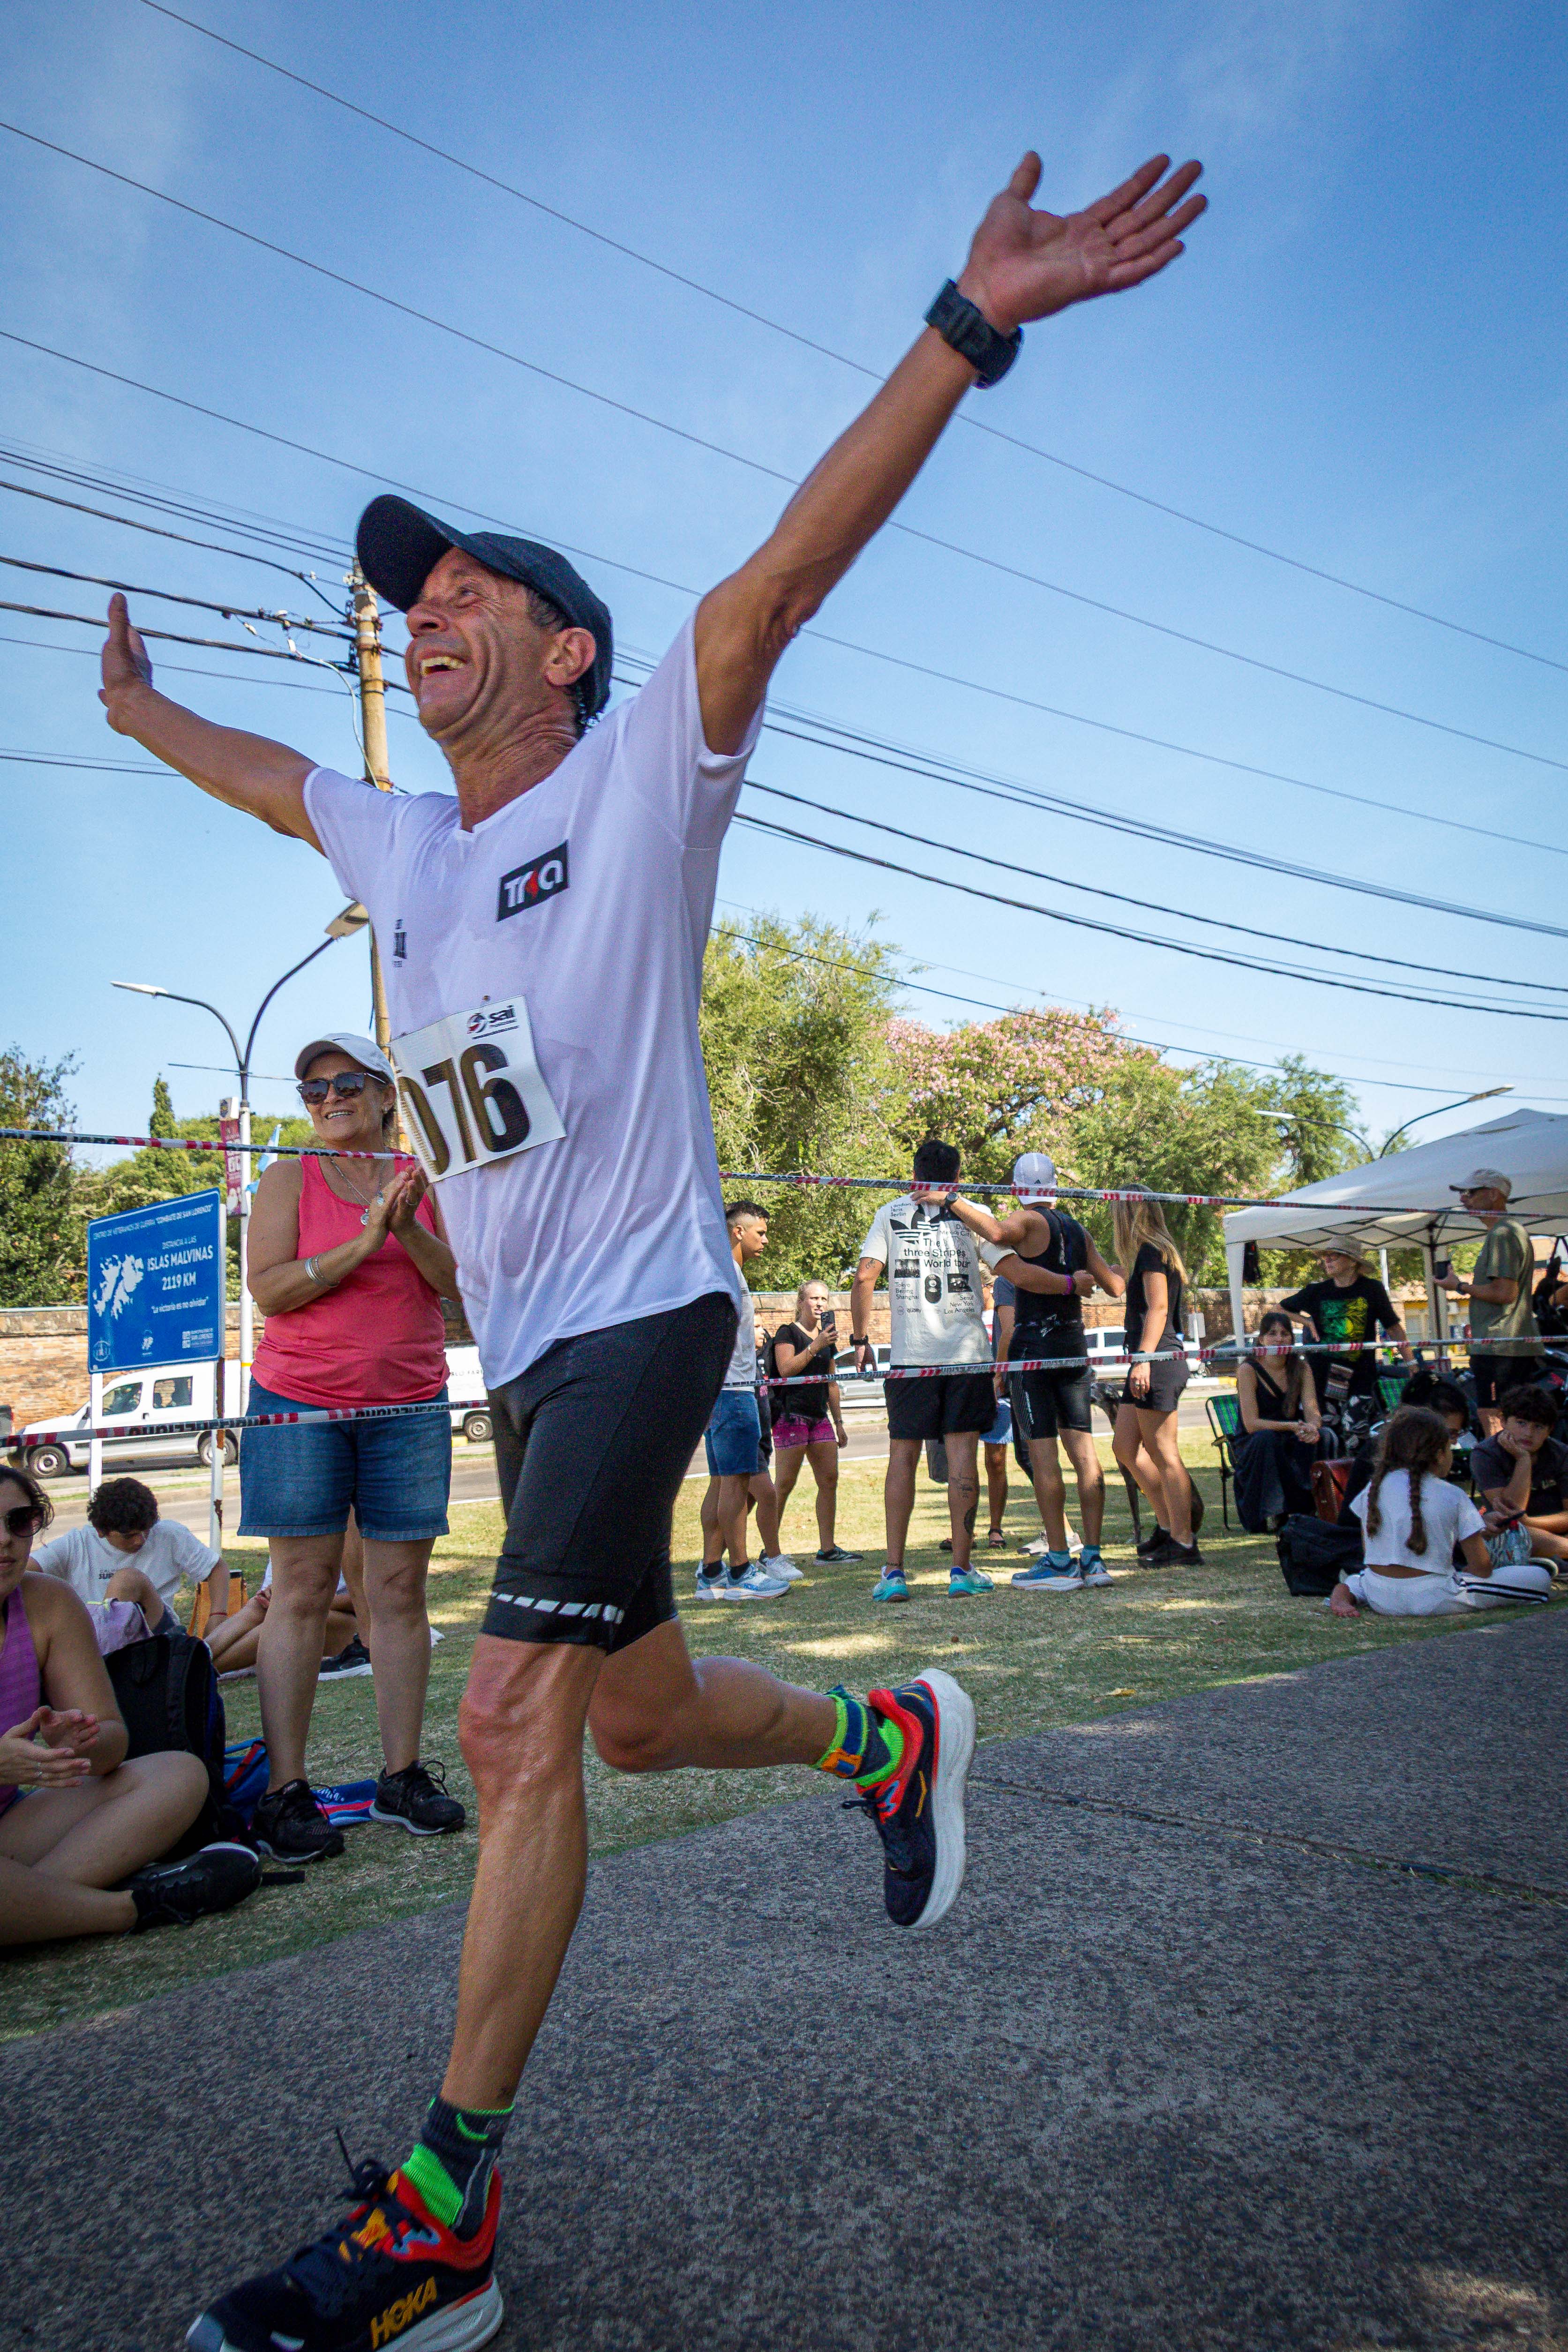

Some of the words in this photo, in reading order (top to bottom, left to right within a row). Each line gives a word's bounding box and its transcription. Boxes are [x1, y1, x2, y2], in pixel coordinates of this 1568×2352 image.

[923, 1238, 940, 1247] The
[147, 1254, 170, 1272] ISLAS
[171, 1245, 214, 1266] MALVINAS
[904, 1248, 930, 1257] three
[932, 1248, 967, 1258] Stripes
[923, 1258, 951, 1268] World
[954, 1259, 971, 1268] tour
[161, 1273, 182, 1291] 2119
[183, 1271, 197, 1287] KM
[370, 2276, 438, 2351] HOKA
